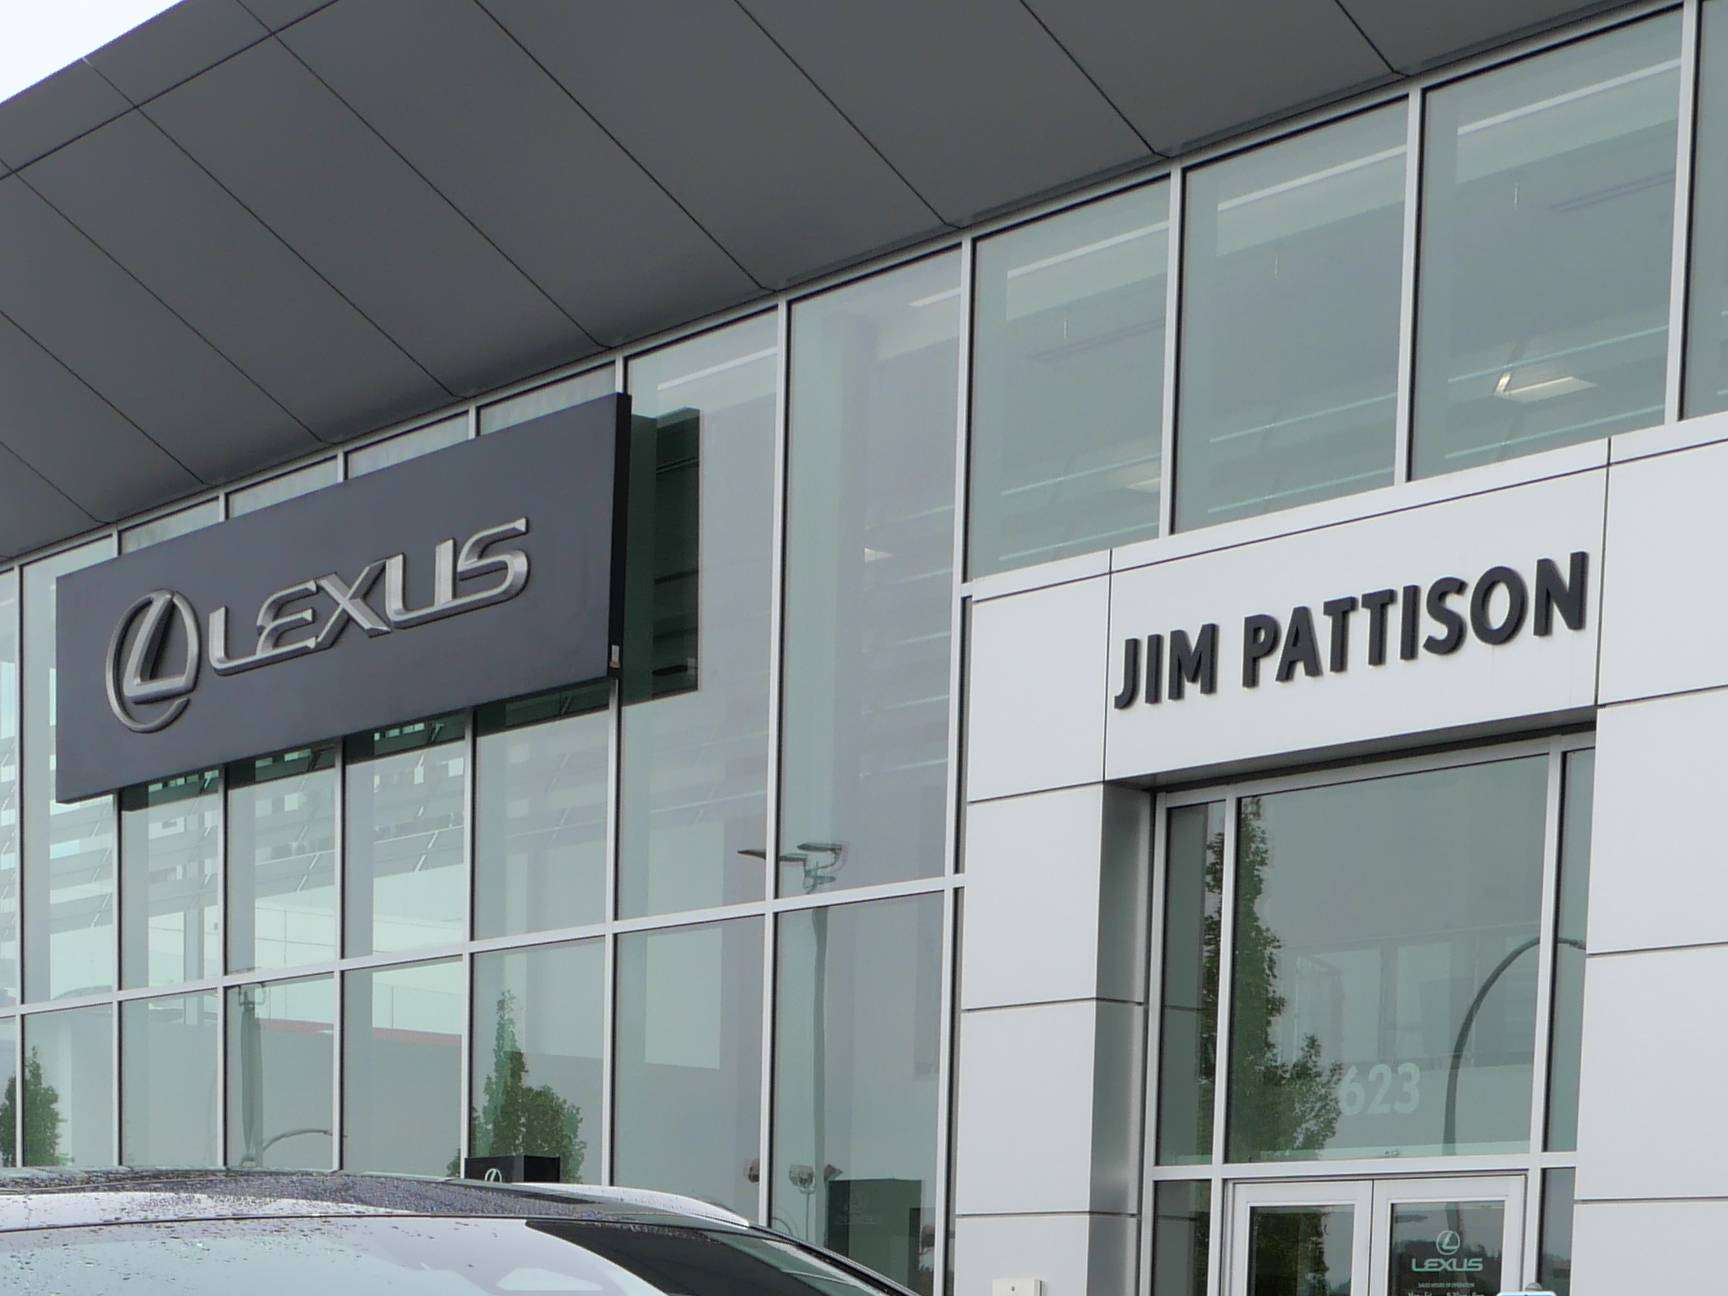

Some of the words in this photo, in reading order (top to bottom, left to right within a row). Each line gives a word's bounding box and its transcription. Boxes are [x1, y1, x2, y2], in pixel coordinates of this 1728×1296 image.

[208, 516, 529, 677] LEXUS
[1114, 622, 1219, 711] JIM
[1242, 550, 1590, 689] PATTISON
[1337, 1062, 1421, 1116] 623
[1411, 1257, 1484, 1272] LEXUS
